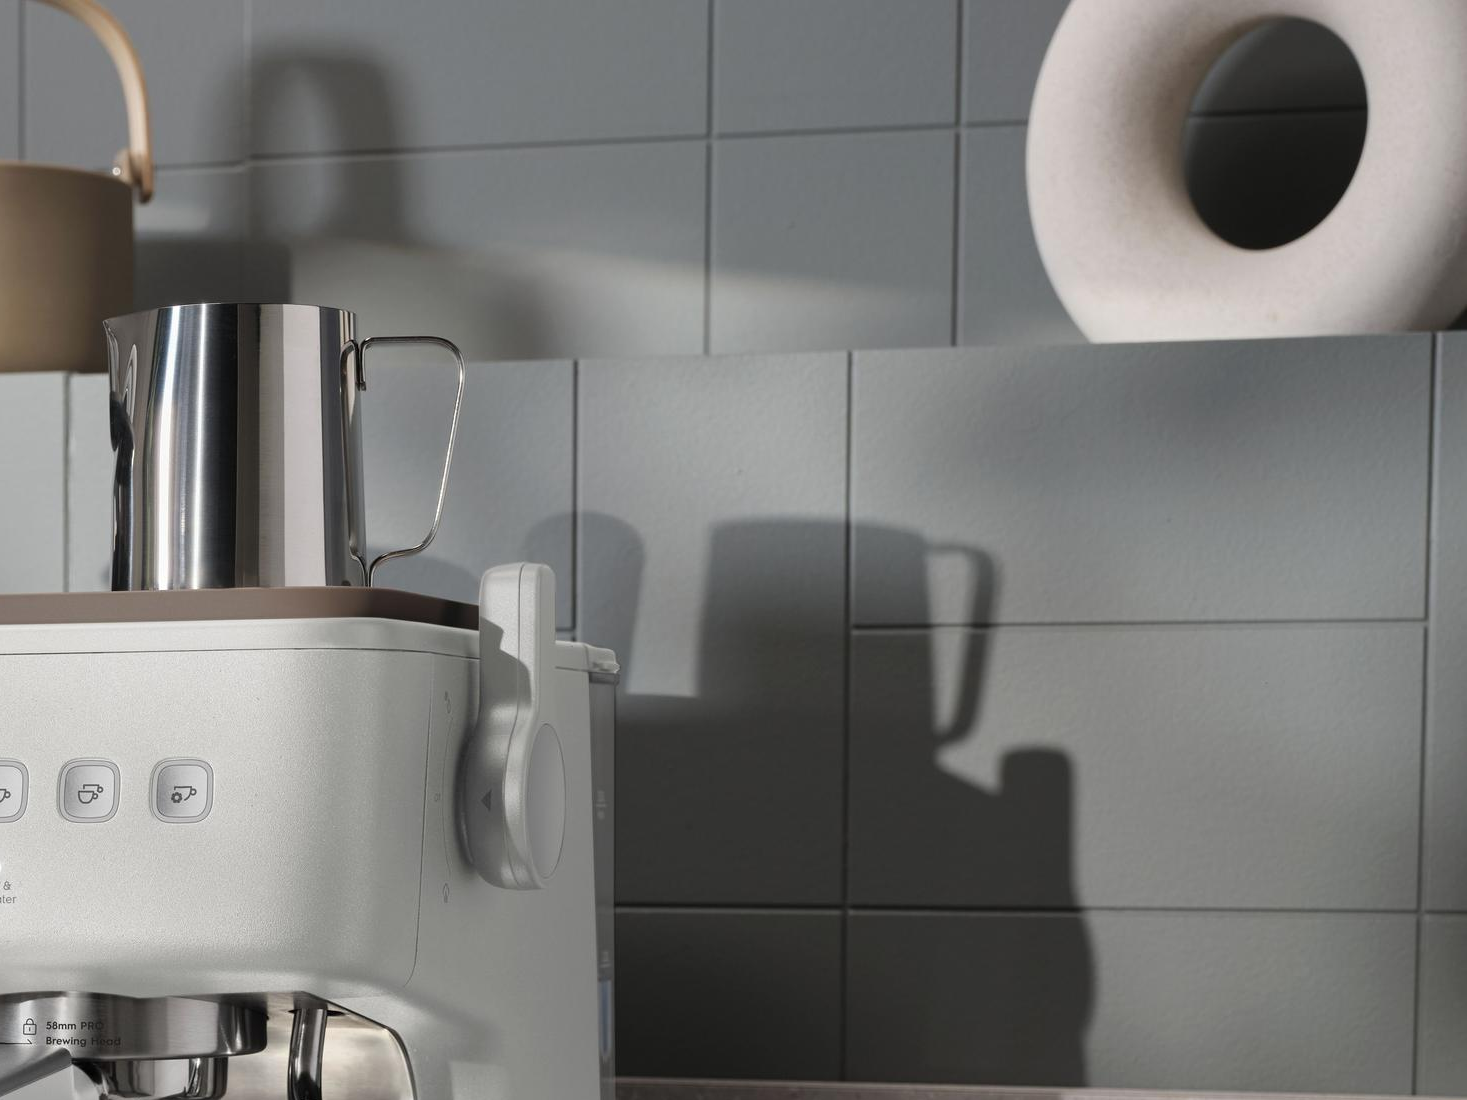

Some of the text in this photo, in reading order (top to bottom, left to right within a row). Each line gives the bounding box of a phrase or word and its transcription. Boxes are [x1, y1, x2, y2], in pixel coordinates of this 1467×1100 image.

[3, 881, 12, 891] &
[45, 1021, 105, 1030] 58mm PRO
[45, 1036, 87, 1048] Brewing
